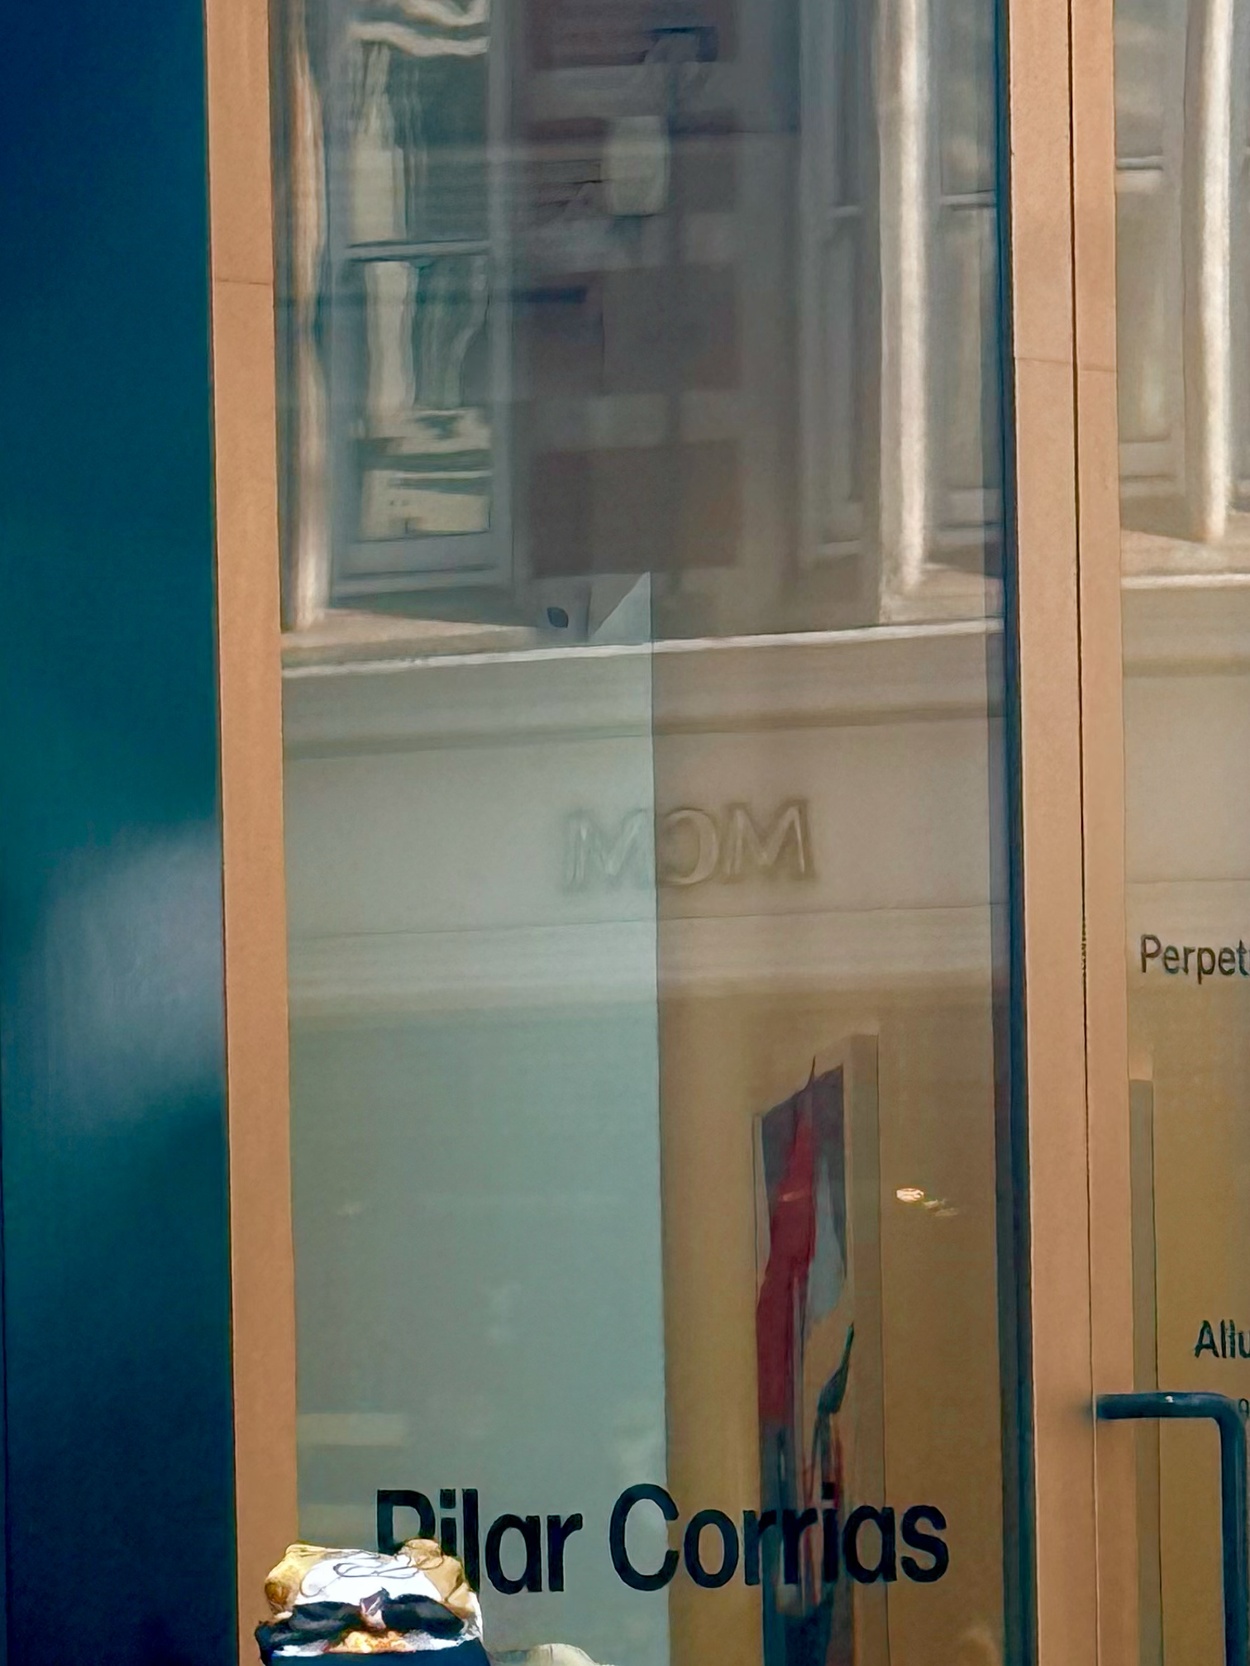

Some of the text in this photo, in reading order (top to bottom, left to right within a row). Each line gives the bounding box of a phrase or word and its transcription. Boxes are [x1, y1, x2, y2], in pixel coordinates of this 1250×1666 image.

[1140, 933, 1250, 985] Perpet
[376, 1483, 950, 1595] Pilar Corrias
